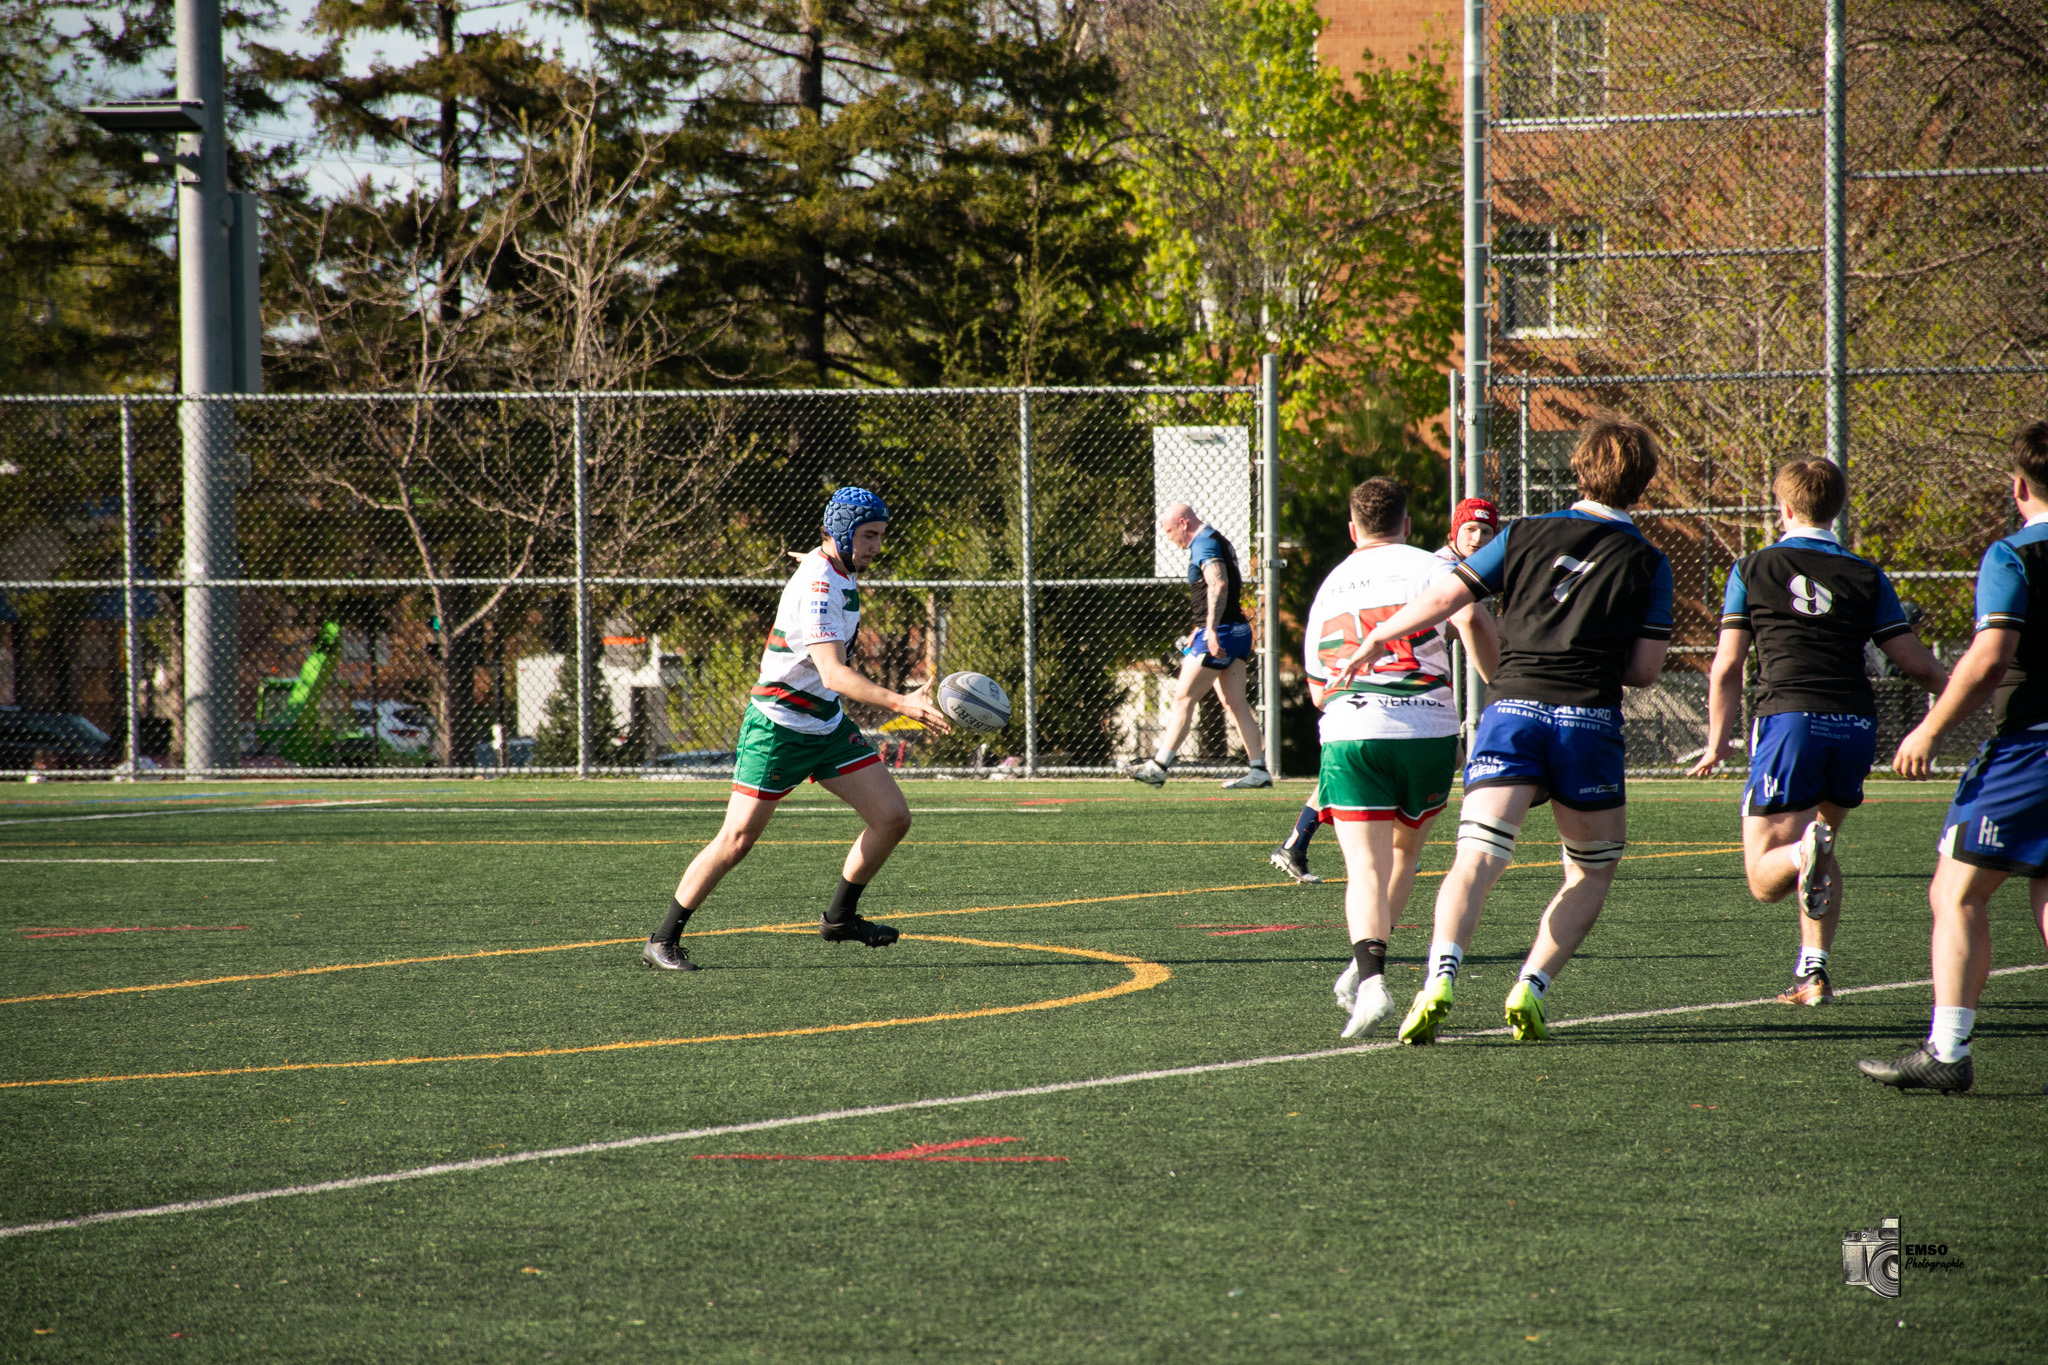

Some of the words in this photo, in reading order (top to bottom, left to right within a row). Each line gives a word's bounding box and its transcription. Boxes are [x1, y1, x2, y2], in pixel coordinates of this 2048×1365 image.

[1331, 579, 1370, 596] TEAM
[1551, 553, 1597, 604] 7
[1788, 573, 1834, 616] 9
[805, 631, 838, 640] AUAK
[1576, 706, 1612, 721] NORD
[1977, 814, 2005, 849] HL
